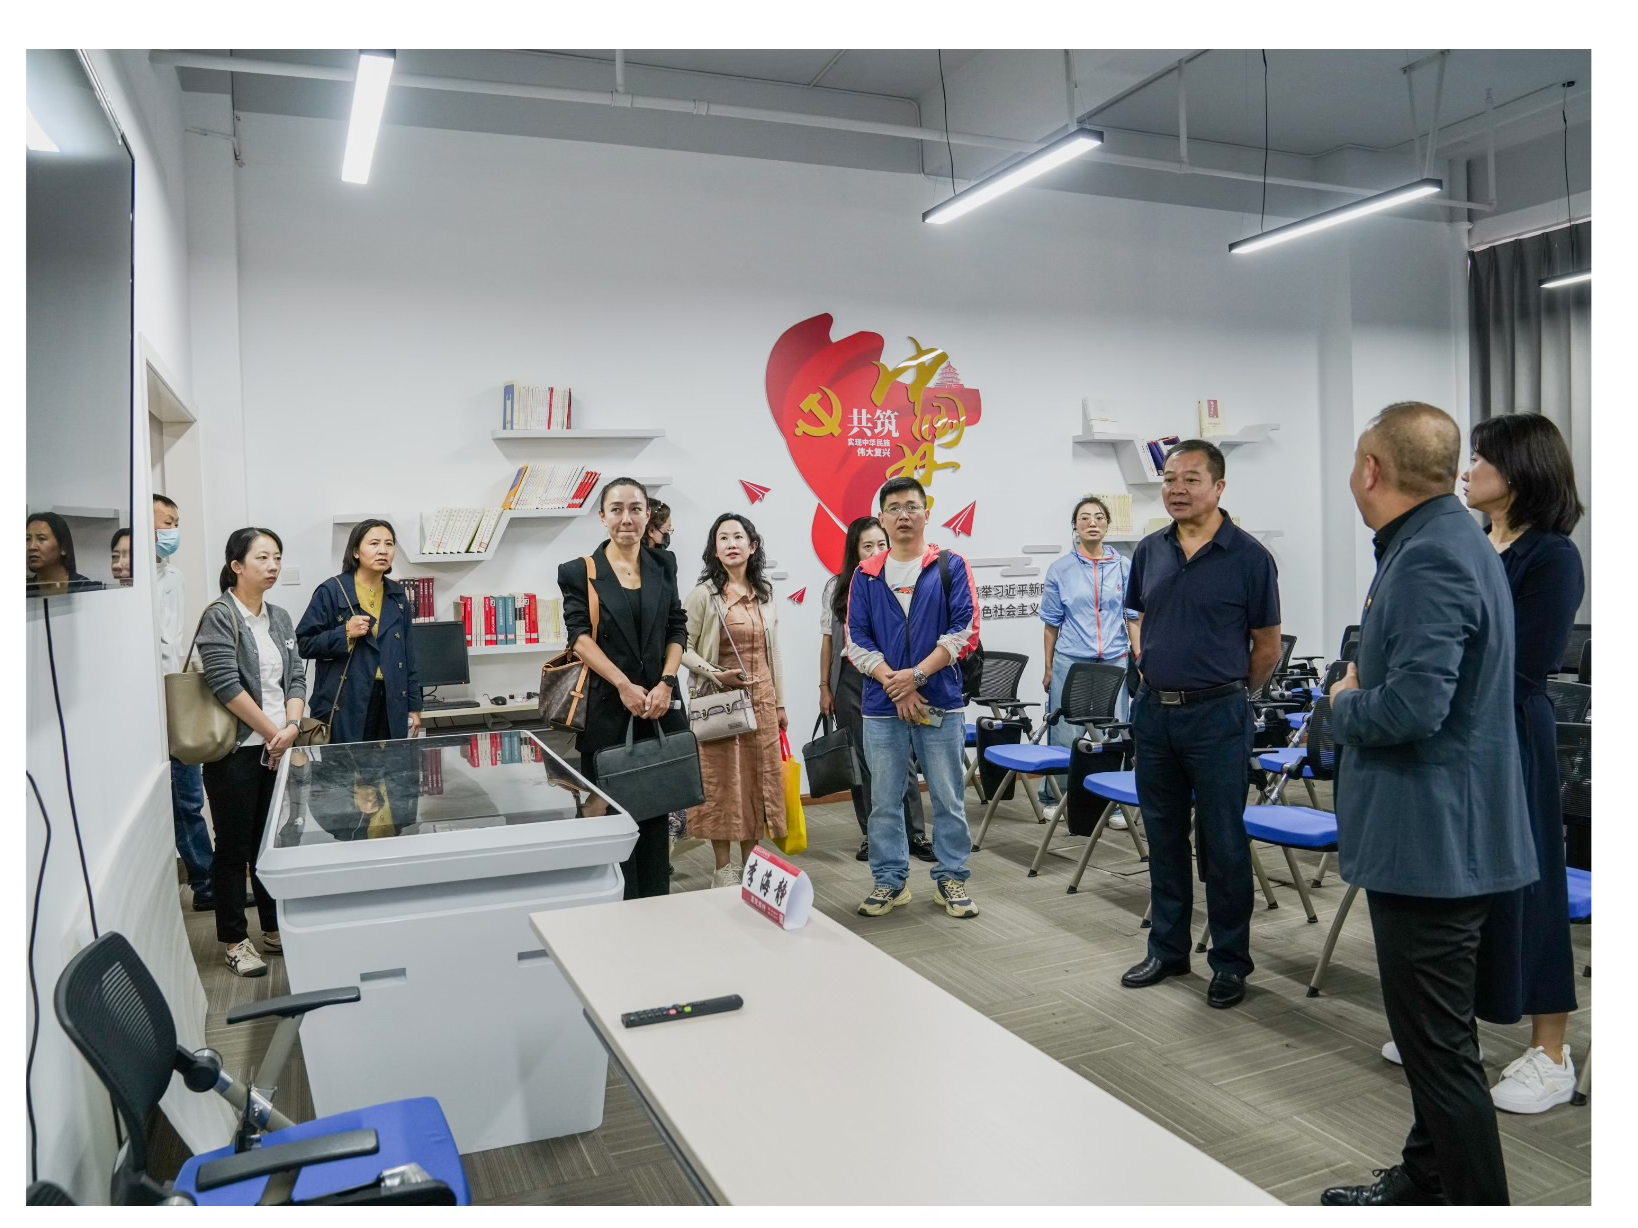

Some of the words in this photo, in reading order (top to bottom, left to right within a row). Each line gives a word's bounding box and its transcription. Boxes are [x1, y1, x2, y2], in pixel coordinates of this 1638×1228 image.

[847, 408, 900, 438] 共筑
[847, 438, 891, 447] 实现中华民族
[857, 447, 891, 458] 伟大复兴
